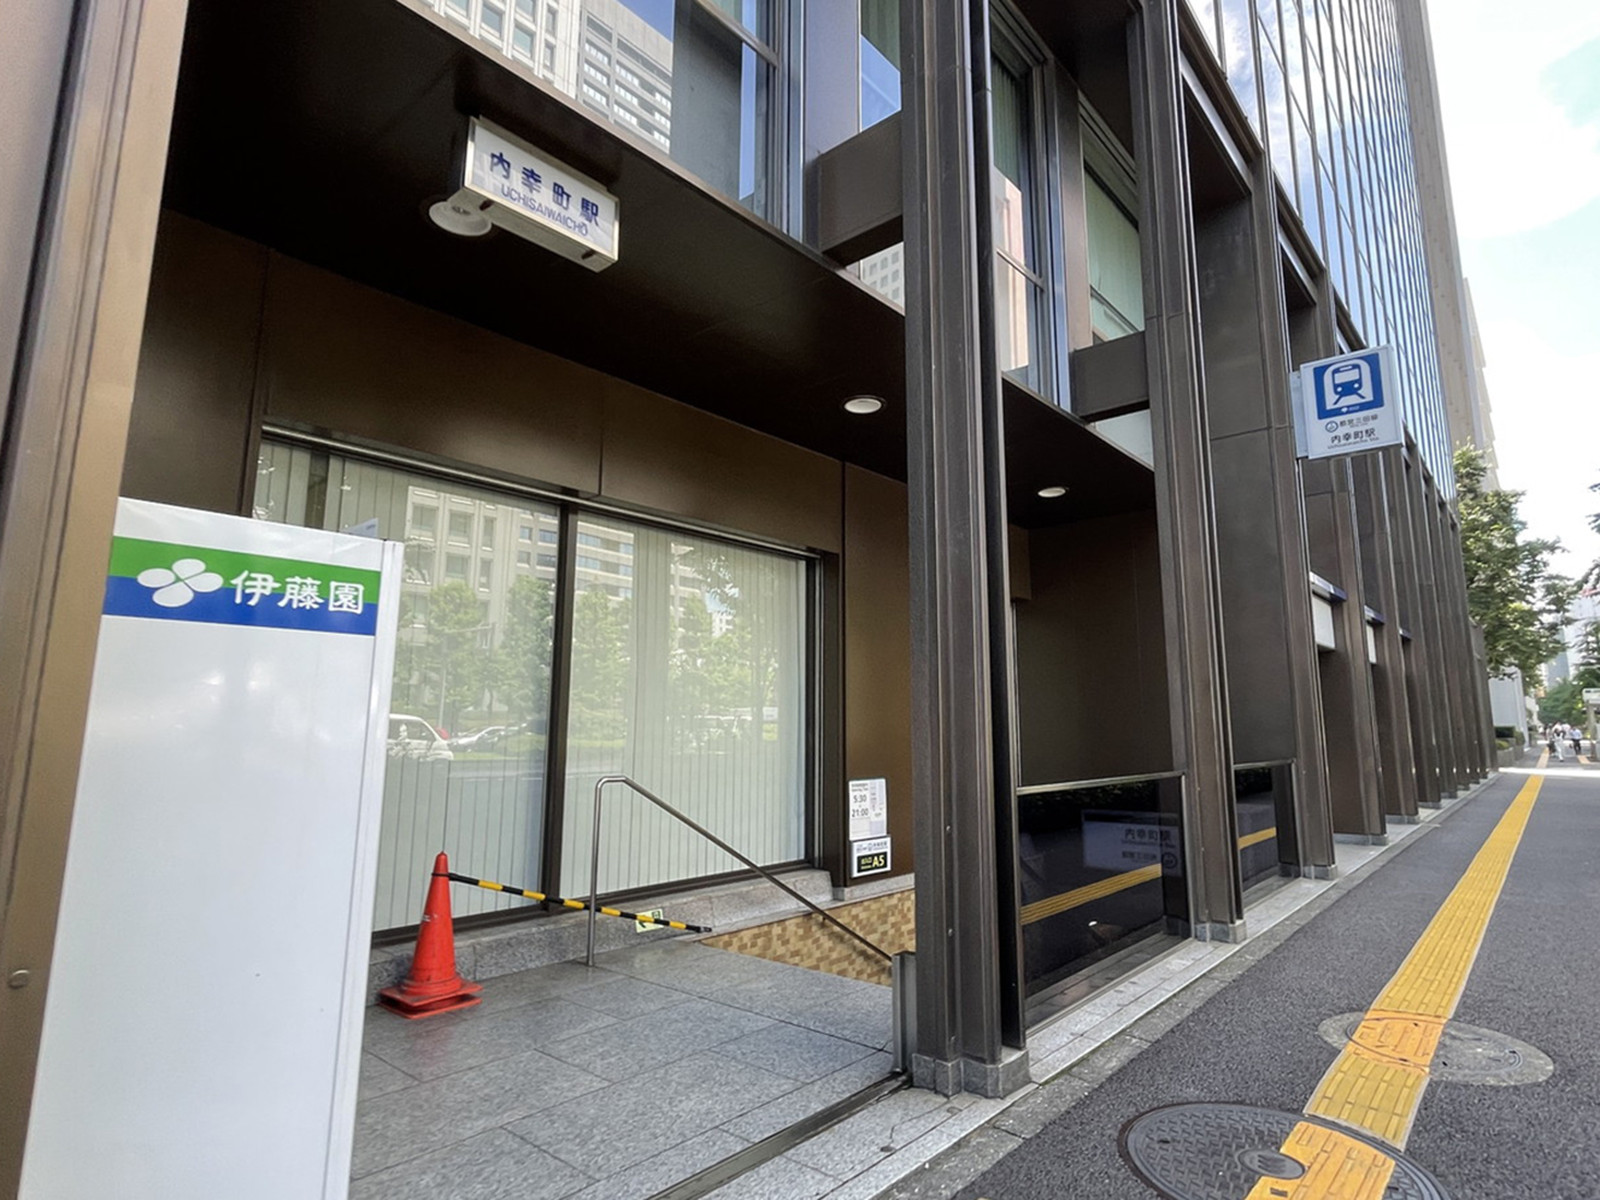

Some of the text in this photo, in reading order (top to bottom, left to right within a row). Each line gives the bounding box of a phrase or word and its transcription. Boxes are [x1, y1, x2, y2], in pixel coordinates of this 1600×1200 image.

[490, 151, 600, 227] 内幸町駅
[1330, 427, 1376, 444] 内幸町駅
[230, 569, 365, 615] 伊藤園
[872, 854, 885, 868] A5
